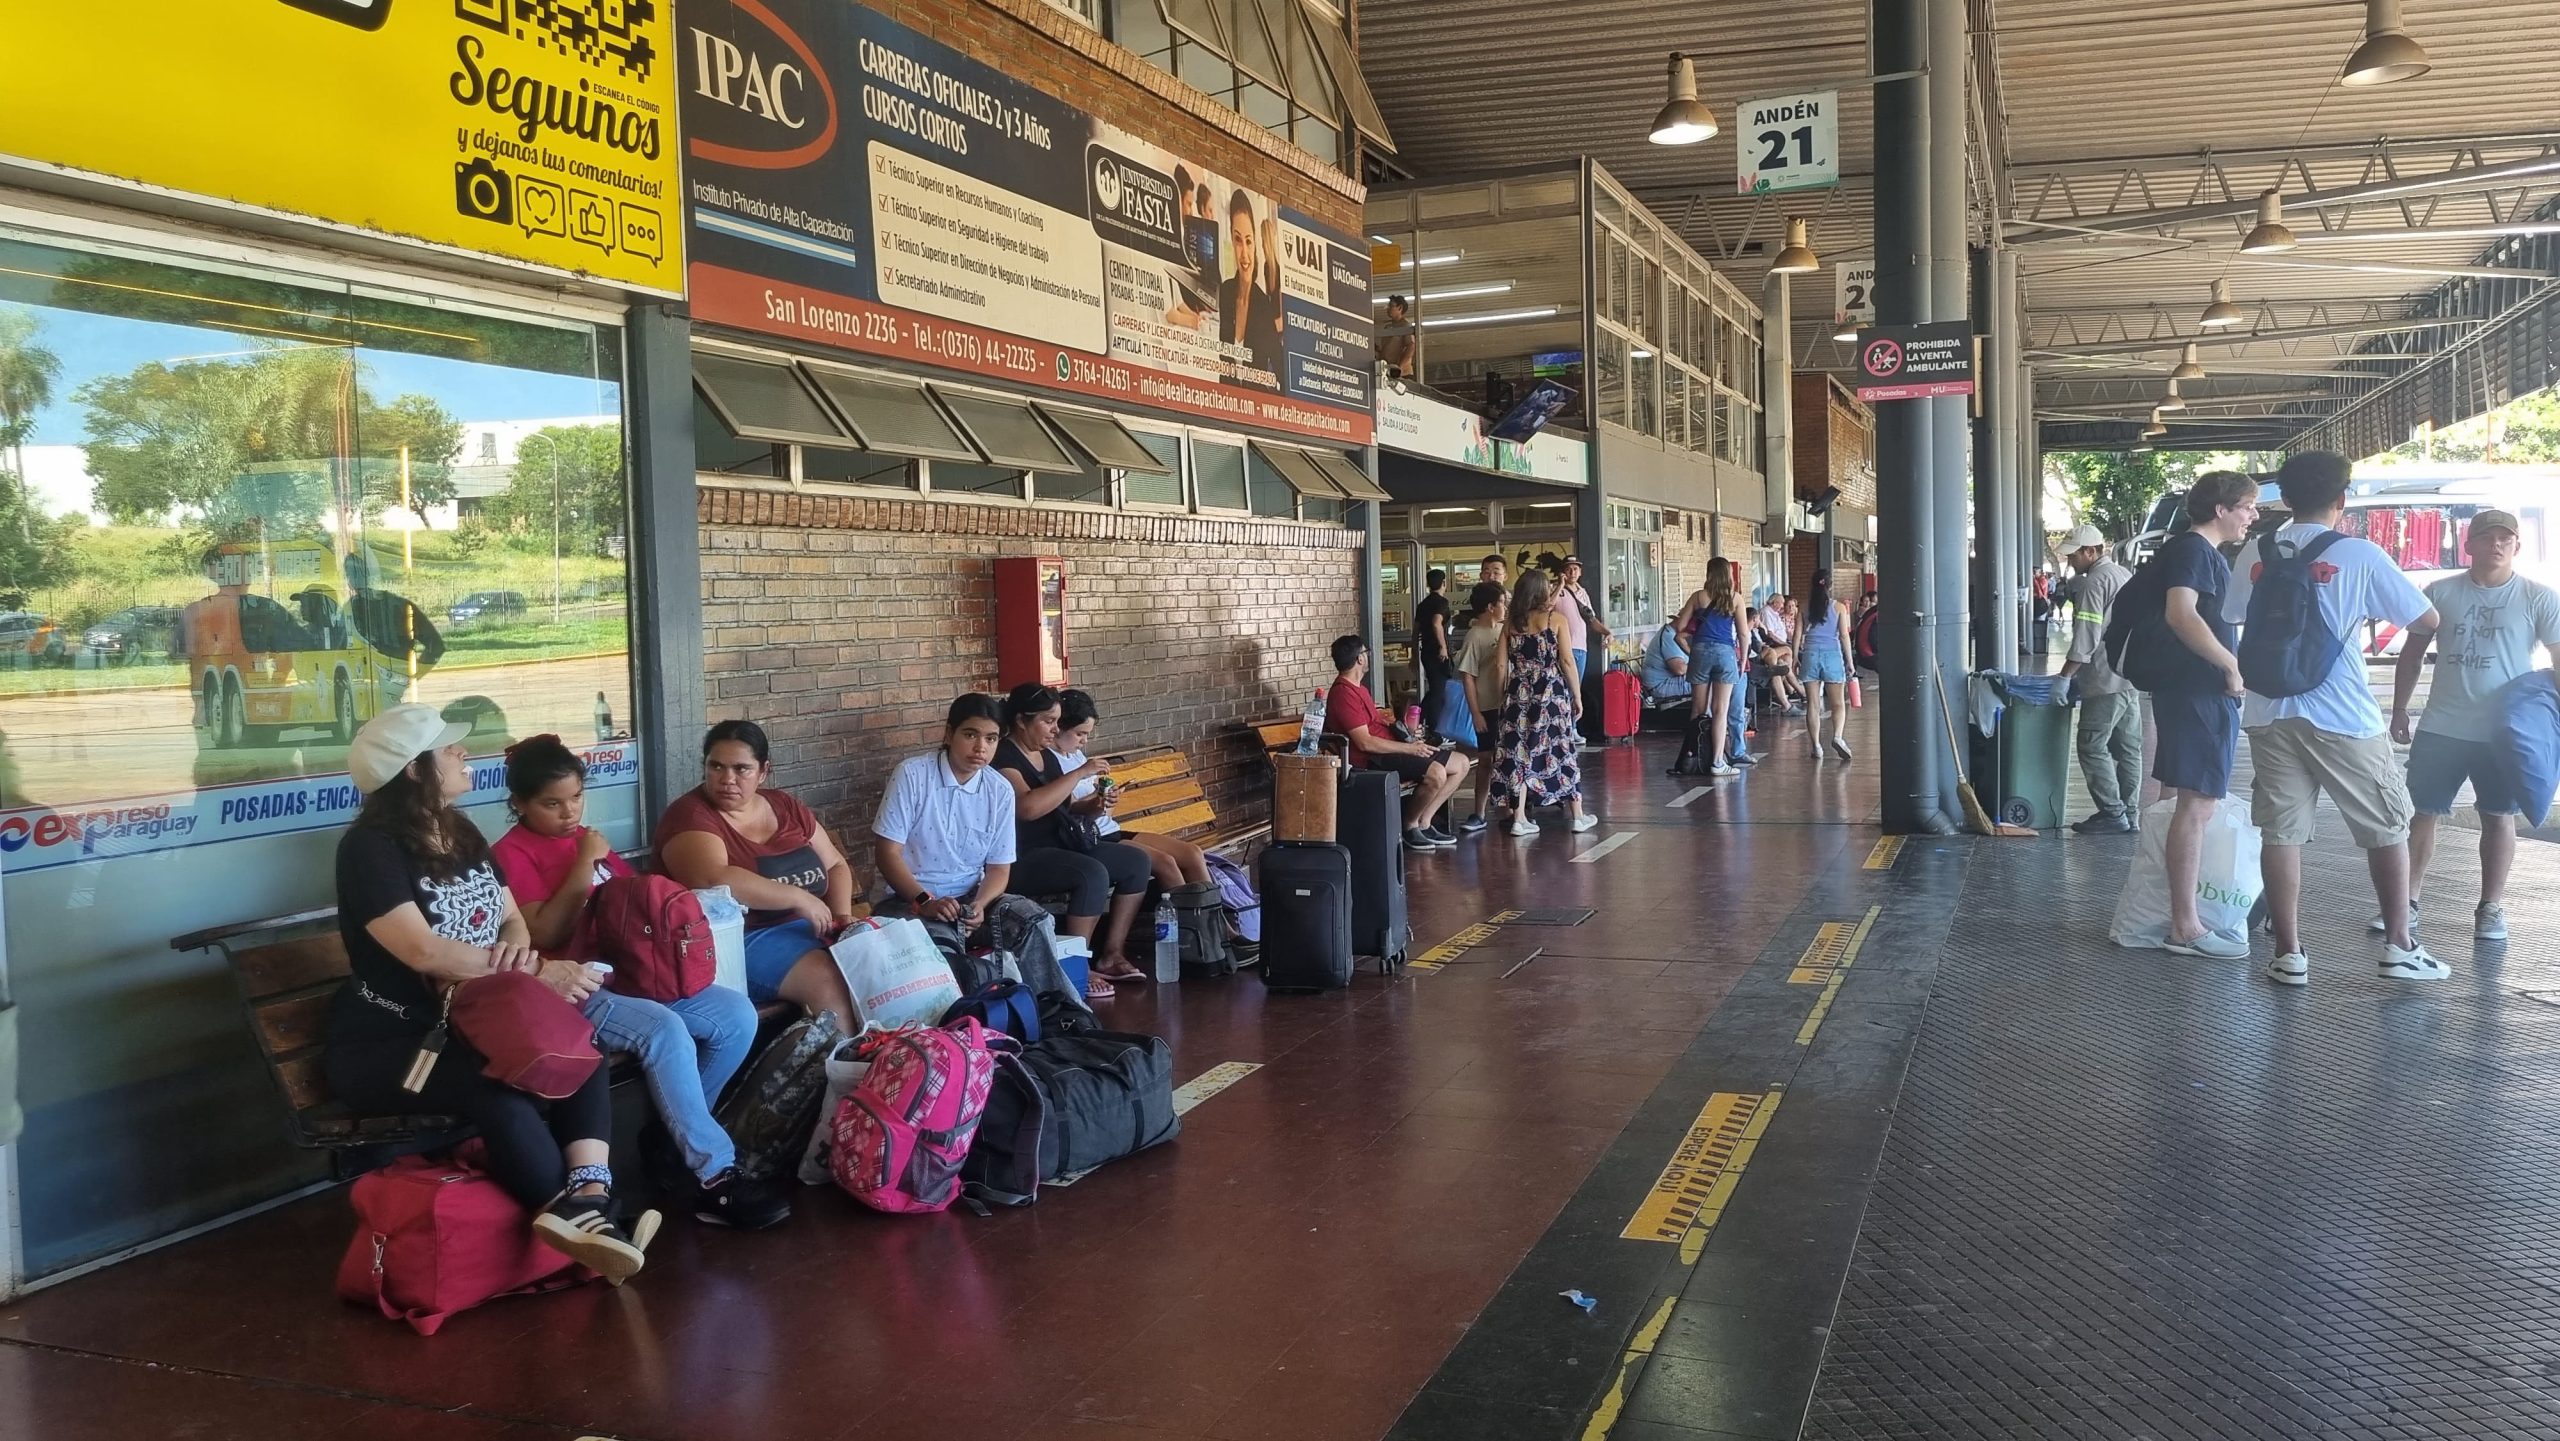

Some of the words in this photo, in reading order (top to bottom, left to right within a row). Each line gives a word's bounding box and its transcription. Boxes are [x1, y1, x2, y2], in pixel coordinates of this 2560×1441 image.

[689, 26, 805, 129] IPAC
[859, 38, 931, 99] CARRERAS
[933, 71, 993, 126] OFICIALES
[994, 99, 1003, 130] 2
[1004, 109, 1012, 139] y
[1013, 107, 1022, 137] 3
[1024, 113, 1051, 151] Años
[450, 35, 660, 160] Seguinos
[593, 83, 625, 102] ESCANEA
[626, 96, 635, 106] EL
[636, 97, 660, 114] CÓDIGO
[1753, 99, 1819, 126] ANDÉN
[863, 84, 917, 135] CURSOS
[919, 108, 968, 155] CORTOS
[457, 127, 468, 152] y
[472, 128, 539, 165] dejanos
[542, 146, 565, 172] tus
[569, 159, 663, 199] comentarios!
[1757, 126, 1813, 171] 21
[888, 160, 915, 186] Técnico
[916, 170, 945, 196] Superior
[946, 184, 954, 198] en
[955, 184, 984, 209] Recursos
[983, 194, 1012, 219] Humanos
[1013, 208, 1017, 222] y
[1018, 207, 1044, 232] Coaching
[1122, 167, 1173, 200] UNIVERSIDAD
[693, 178, 732, 208] Instituto
[733, 190, 768, 219] Privado
[770, 203, 781, 223] de
[783, 206, 800, 228] Alta
[801, 211, 855, 243] Capacitación
[1123, 186, 1174, 233] FASTA
[891, 197, 918, 221] Técnico
[918, 207, 947, 231] Superior
[948, 219, 957, 233] en
[957, 219, 989, 244] Seguridad
[990, 233, 995, 245] e
[995, 231, 1018, 252] Higiene
[1019, 240, 1028, 256] del
[1028, 243, 1049, 264] trabajo
[894, 233, 920, 258] Técnico
[921, 242, 949, 267] Superior
[951, 253, 959, 267] en
[960, 253, 988, 276] Dirección
[989, 263, 997, 278] de
[998, 264, 1025, 287] Negocios
[1025, 276, 1029, 290] y
[1030, 274, 1071, 300] Administración
[1071, 286, 1078, 302] de
[1079, 288, 1100, 308] Personal
[1295, 235, 1323, 272] UAI
[895, 269, 938, 295] Secretariado
[939, 278, 986, 308] Administrativo
[1109, 259, 1134, 284] CENTRO
[1135, 267, 1164, 293] TUTORIAL
[1284, 275, 1289, 287] El
[1332, 265, 1367, 291] UAIOnline
[1847, 270, 1874, 281] AND
[1110, 282, 1134, 302] POSADAS
[1139, 290, 1165, 311] ELDORADO
[1845, 285, 1875, 310] 2
[765, 289, 795, 324] San
[800, 297, 861, 337] Lorenzo
[864, 311, 897, 344] 2236
[912, 322, 981, 365] Tel.:(0376)
[985, 339, 1036, 373] 44-22235
[1113, 315, 1146, 334] CARRERAS
[1146, 322, 1151, 334] Y
[1151, 323, 1194, 346] LICENCIATURAS
[1194, 334, 1198, 346] A
[1287, 311, 1327, 336] TECNICATURAS
[1332, 326, 1369, 349] LICENCIATURAS
[1906, 339, 1961, 350] PROHIBIDA
[1112, 335, 1142, 354] ARTICULÁ
[1143, 345, 1150, 357] TU
[1152, 345, 1189, 367] TECNICATURA
[1192, 355, 1230, 377] PROFESORADO
[1315, 339, 1319, 352] A
[1319, 341, 1344, 360] DISTANCIA
[1906, 352, 1919, 361] LA
[1920, 350, 1953, 360] VENTA
[1906, 361, 1968, 372] AMBULANTE
[1073, 357, 1130, 392] 3764-742631
[1140, 378, 1255, 417] info@dealtacapacitacion.com
[1262, 402, 1350, 434] www.dealtacapacitacion.com
[1930, 385, 1946, 394] MU
[2463, 604, 2505, 621] ART
[2454, 623, 2467, 637] IS
[2471, 625, 2505, 641] NOT
[2464, 639, 2476, 656] A
[2447, 653, 2496, 669] CRIME
[586, 760, 638, 776] araguay
[33, 803, 171, 848] expreso
[1676, 1126, 1713, 1161] ESPERE
